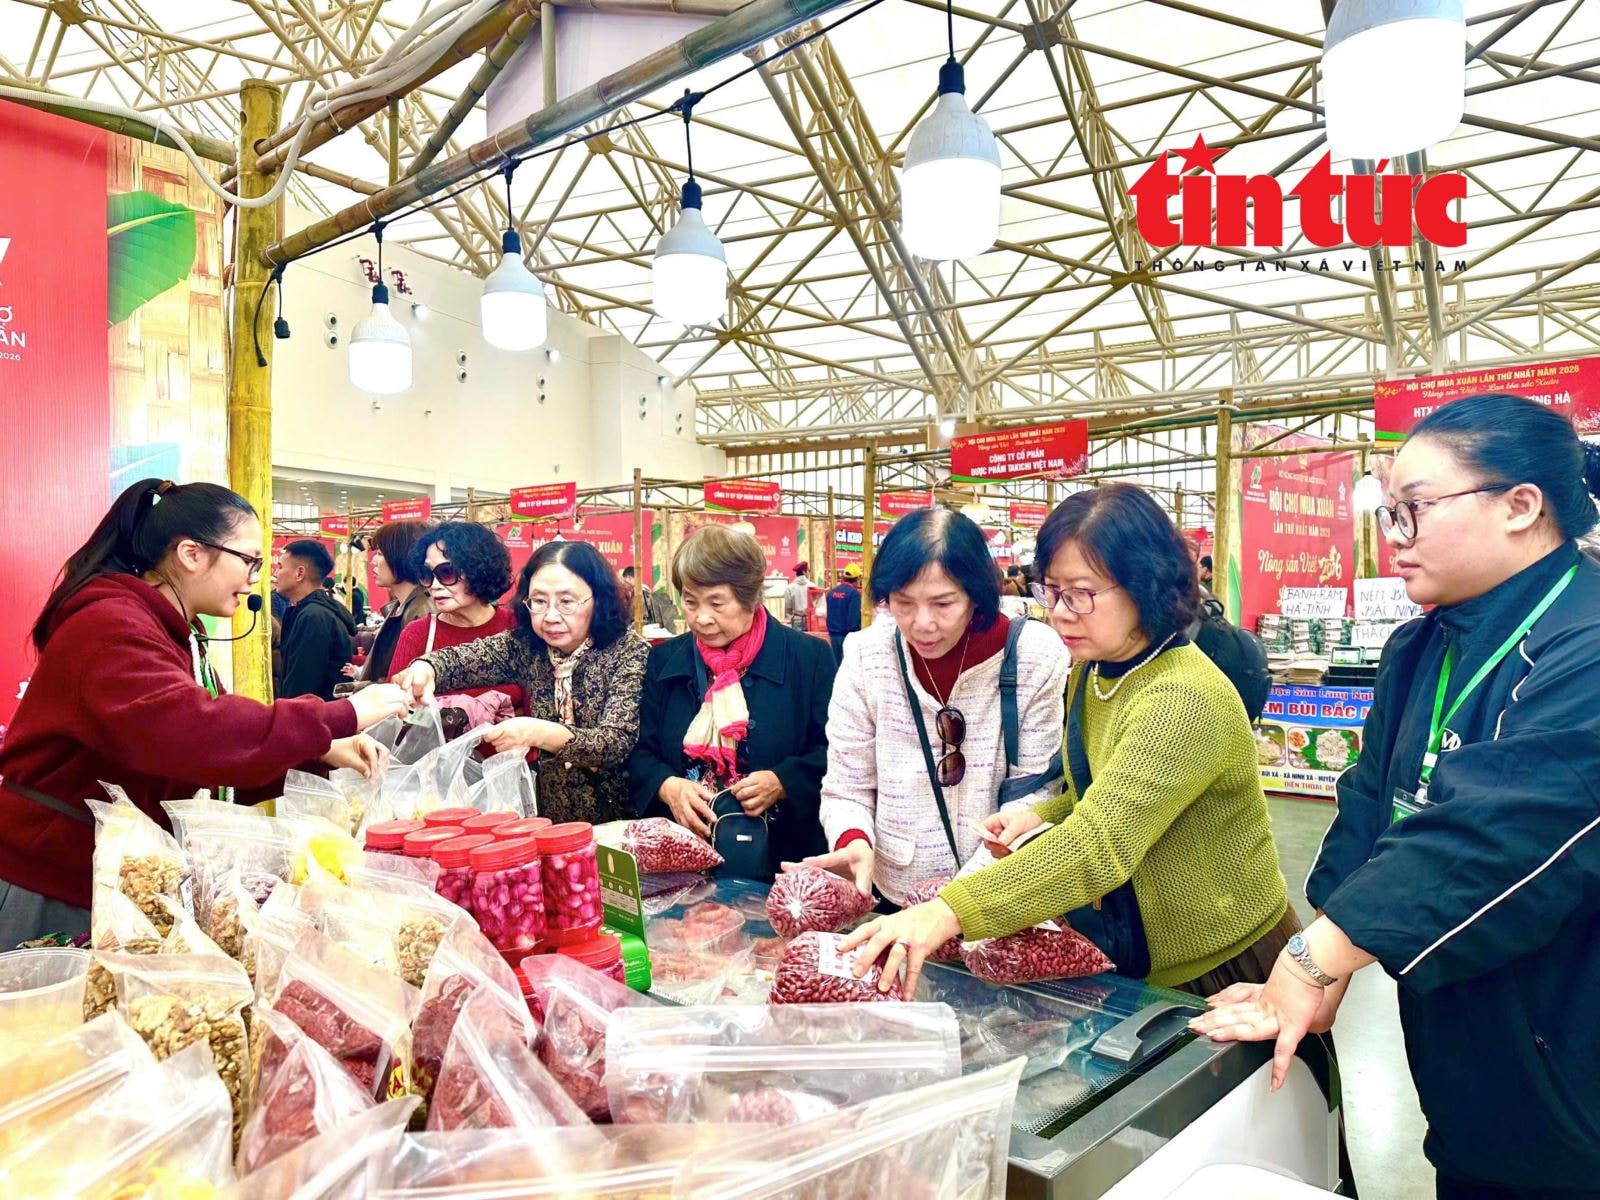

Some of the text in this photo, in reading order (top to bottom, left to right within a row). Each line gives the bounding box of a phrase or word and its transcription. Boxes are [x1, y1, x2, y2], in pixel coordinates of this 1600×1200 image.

[1406, 365, 1580, 392] HỘI CHỢ MÙA XUÂN LẦN THỨ NHẤT NĂM 2026
[1414, 405, 1432, 418] HTX
[1554, 390, 1571, 404] HÀ
[988, 463, 1006, 475] PHẨM
[1008, 462, 1032, 473] TAKICHI
[1032, 460, 1046, 472] VIỆT
[1048, 458, 1064, 467] NAM
[989, 448, 1044, 463] CÔNG TY CỔ PHẦN
[1269, 486, 1282, 516] HỘI
[1284, 492, 1298, 518] CHỢ
[1300, 492, 1316, 515] MÙA
[1316, 495, 1334, 518] XUÂN
[599, 540, 623, 554] XUÂN
[1258, 550, 1284, 580] Nông
[1288, 700, 1316, 715] BÙI
[1322, 700, 1356, 718] BẮC
